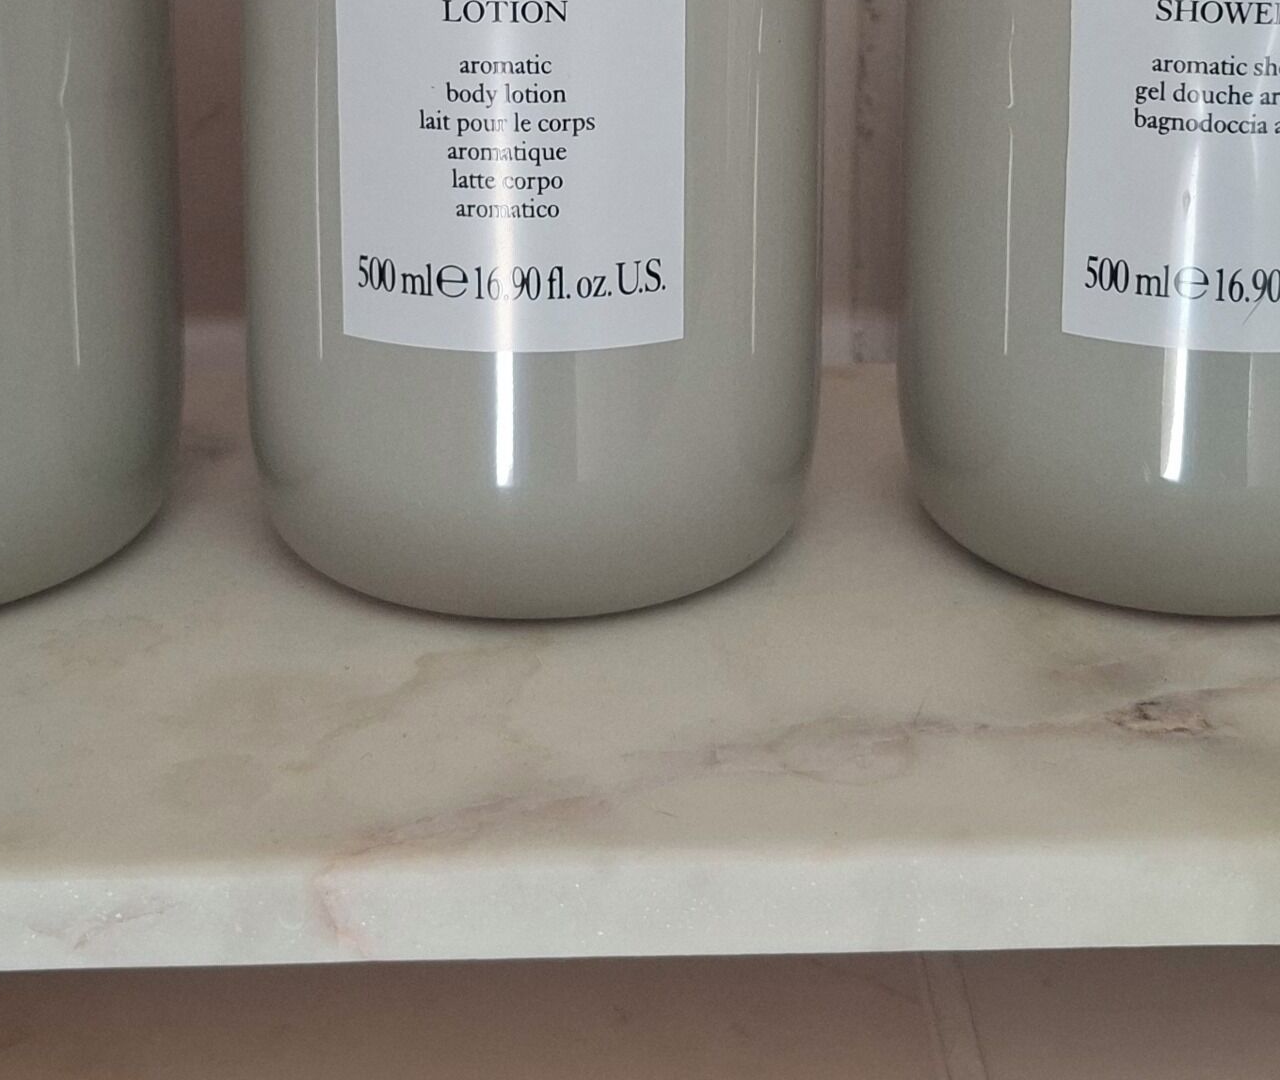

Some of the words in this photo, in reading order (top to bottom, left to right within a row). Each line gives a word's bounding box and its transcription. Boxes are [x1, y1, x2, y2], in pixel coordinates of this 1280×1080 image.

[441, 0, 569, 24] LOTION
[459, 53, 553, 75] aromatic
[1151, 54, 1248, 77] aromatic
[445, 81, 497, 110] body
[504, 82, 567, 104] lotion
[1134, 80, 1166, 105] gel
[1172, 81, 1254, 106] douche
[418, 108, 451, 131] lait
[456, 117, 507, 138] pour
[513, 111, 532, 133] le
[537, 116, 596, 138] corps
[1133, 106, 1269, 136] bagnodoccia
[447, 140, 568, 168] aromatique
[451, 167, 496, 190] latte
[502, 175, 564, 196] corpo
[455, 197, 560, 219] aromatico
[357, 254, 397, 293] 500
[400, 262, 434, 297] ml
[473, 265, 542, 301] 16.90
[546, 265, 572, 301] fl.
[576, 275, 613, 299] oz.
[615, 257, 667, 296] U.S.
[1084, 255, 1130, 294] 500
[1134, 263, 1171, 299] ml
